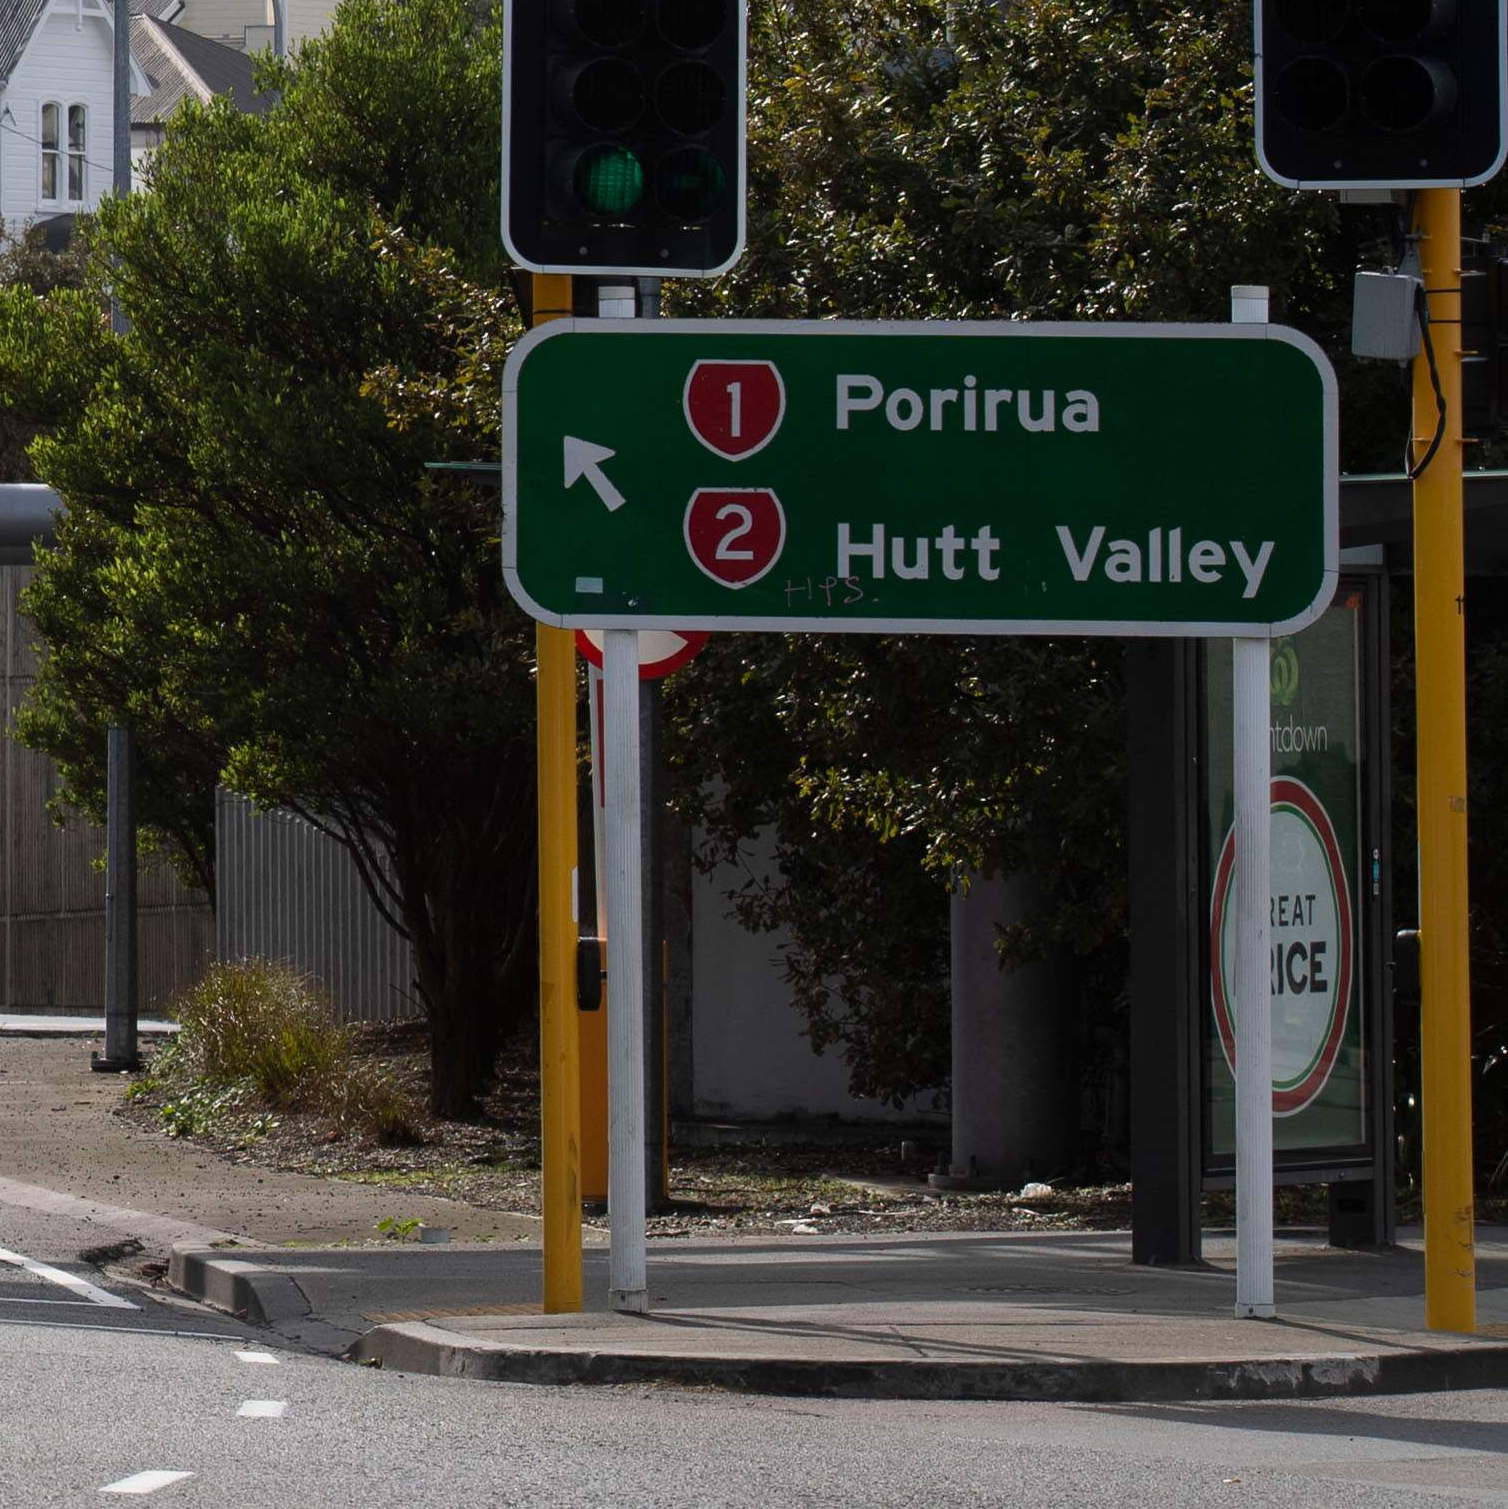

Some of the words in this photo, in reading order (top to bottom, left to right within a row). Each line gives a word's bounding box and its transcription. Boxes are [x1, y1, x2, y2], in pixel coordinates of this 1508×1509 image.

[724, 381, 743, 436] 1
[837, 374, 1101, 433] Porirua
[715, 504, 755, 562] 2
[836, 523, 1002, 582] Hutt
[1056, 526, 1277, 599] Valley
